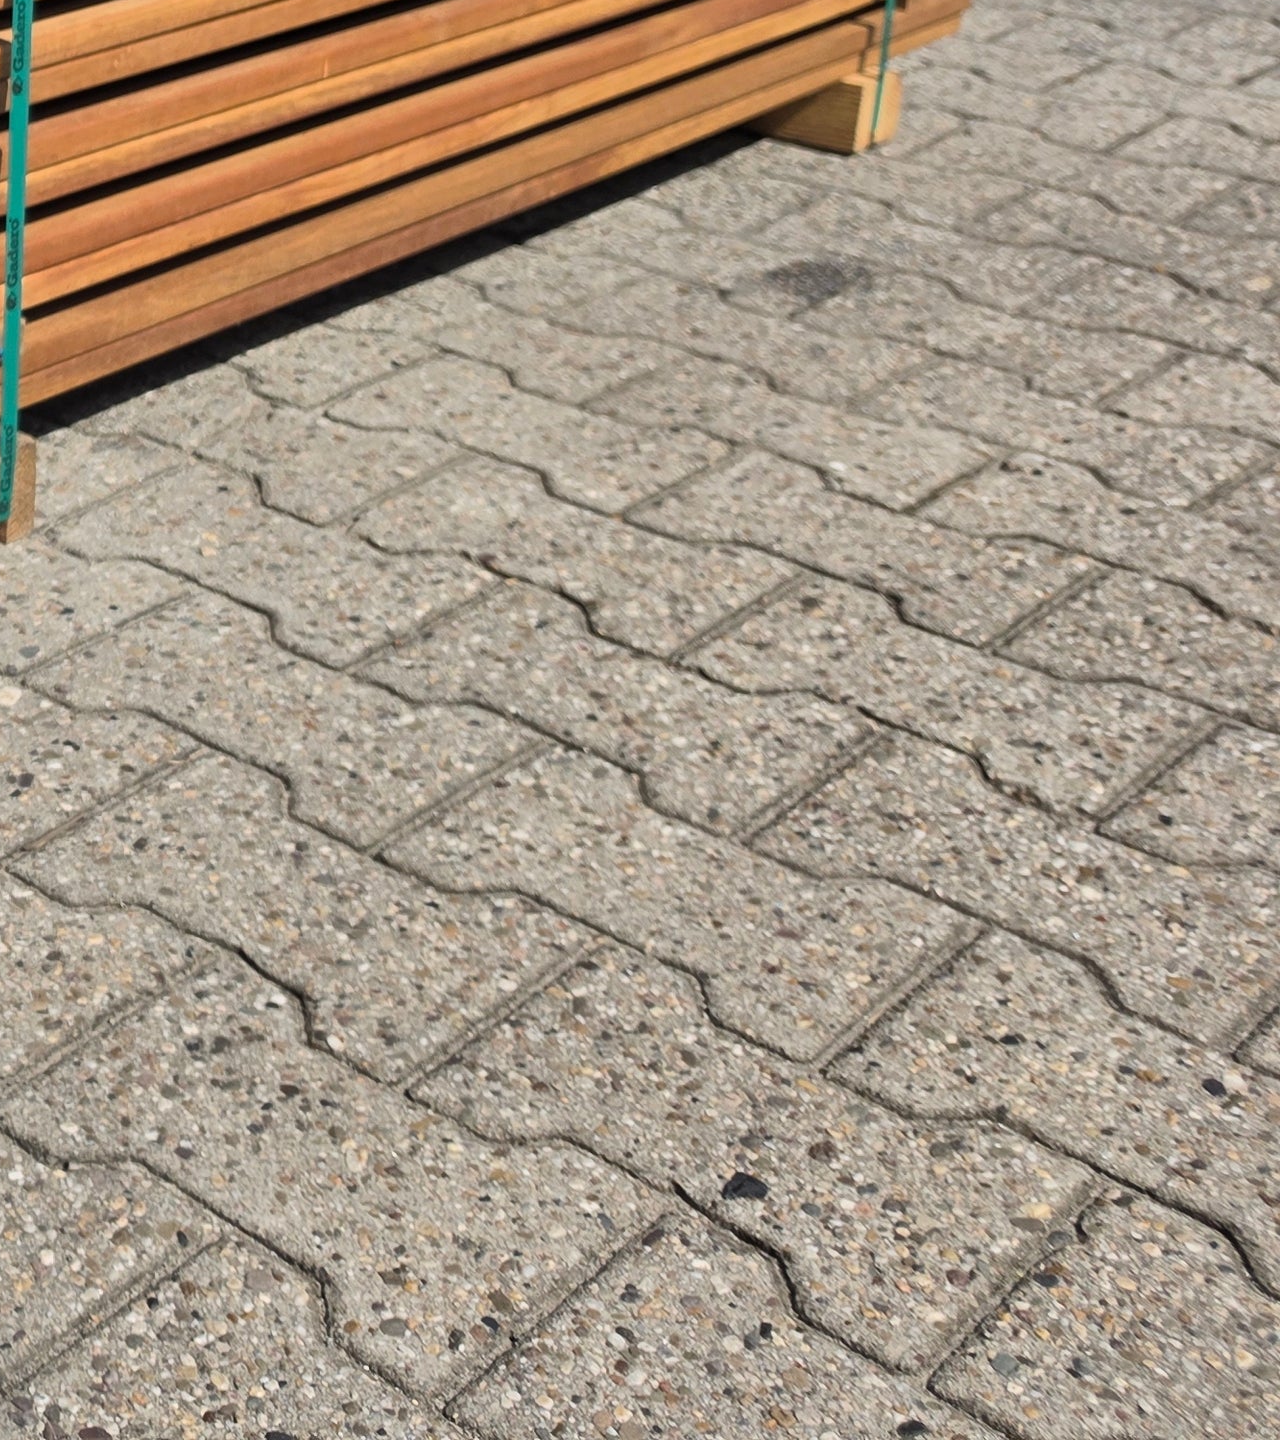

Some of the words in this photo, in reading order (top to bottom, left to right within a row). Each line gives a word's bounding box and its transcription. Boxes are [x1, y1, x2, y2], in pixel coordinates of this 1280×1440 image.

[13, 0, 26, 73] Gadero
[7, 218, 19, 287] Gadero
[1, 426, 14, 492] Gadero
